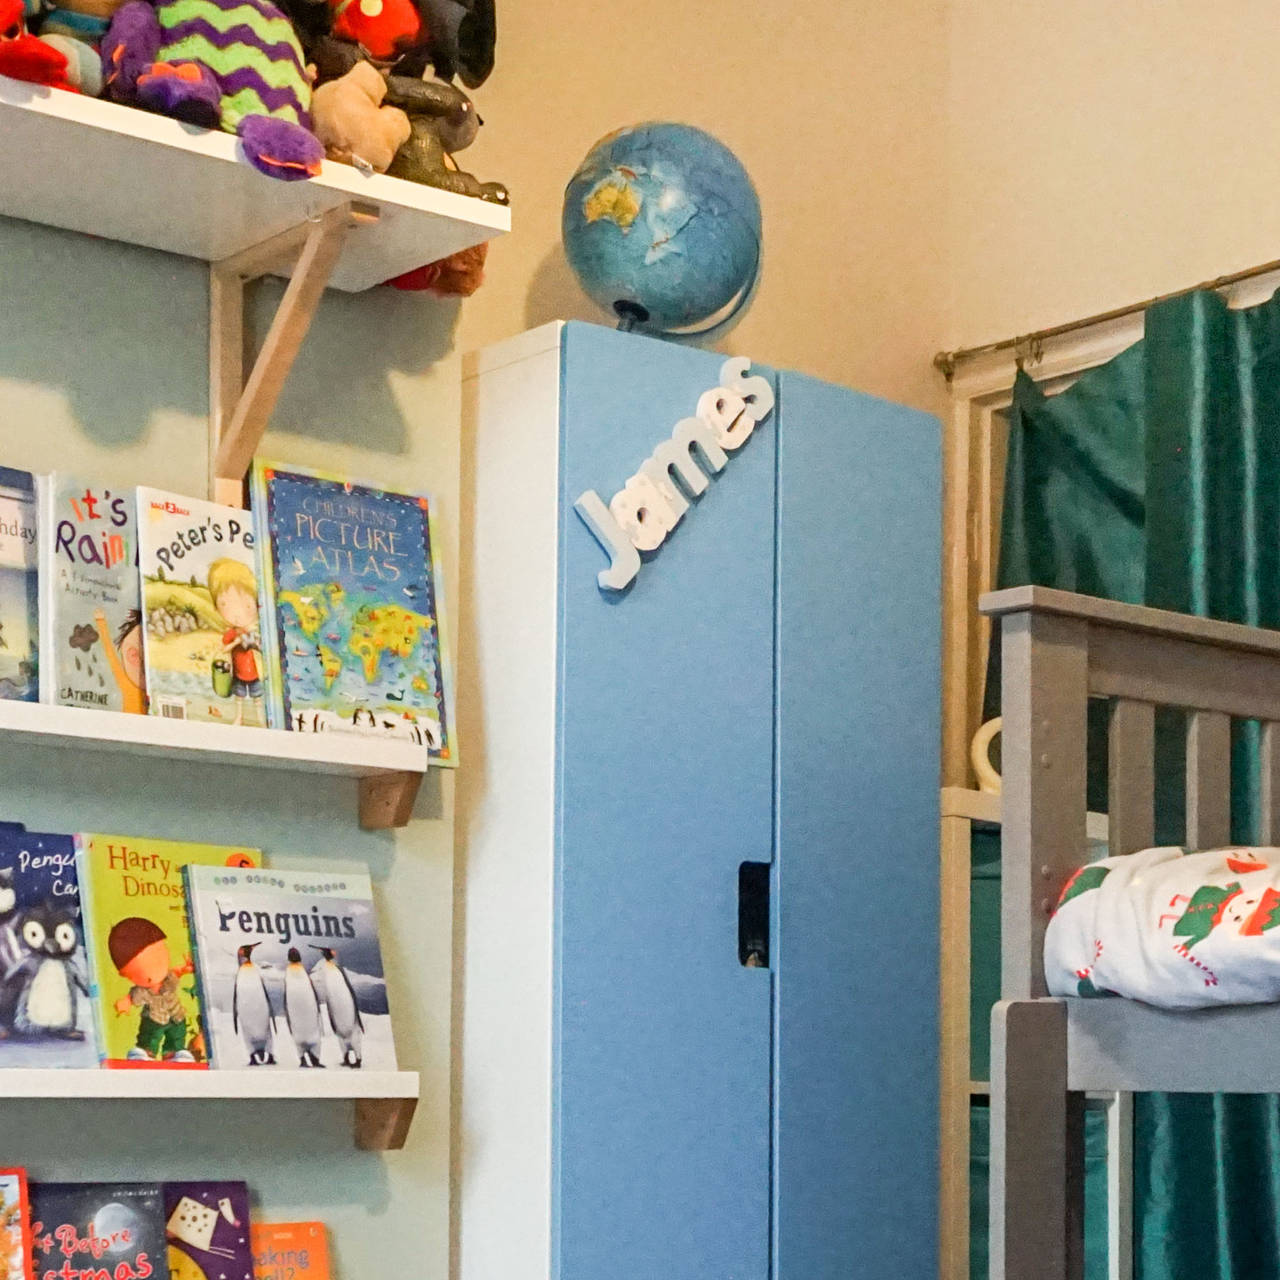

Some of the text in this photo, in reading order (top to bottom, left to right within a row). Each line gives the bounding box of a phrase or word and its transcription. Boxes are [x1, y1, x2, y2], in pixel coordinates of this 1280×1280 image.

[572, 355, 776, 590] James
[68, 488, 129, 528] It's
[156, 516, 224, 572] Peter's
[295, 512, 408, 558] PICTURE
[310, 545, 401, 583] ATLAS
[107, 845, 171, 881] Harry
[215, 899, 356, 944] Penguins
[55, 1221, 132, 1260] Before
